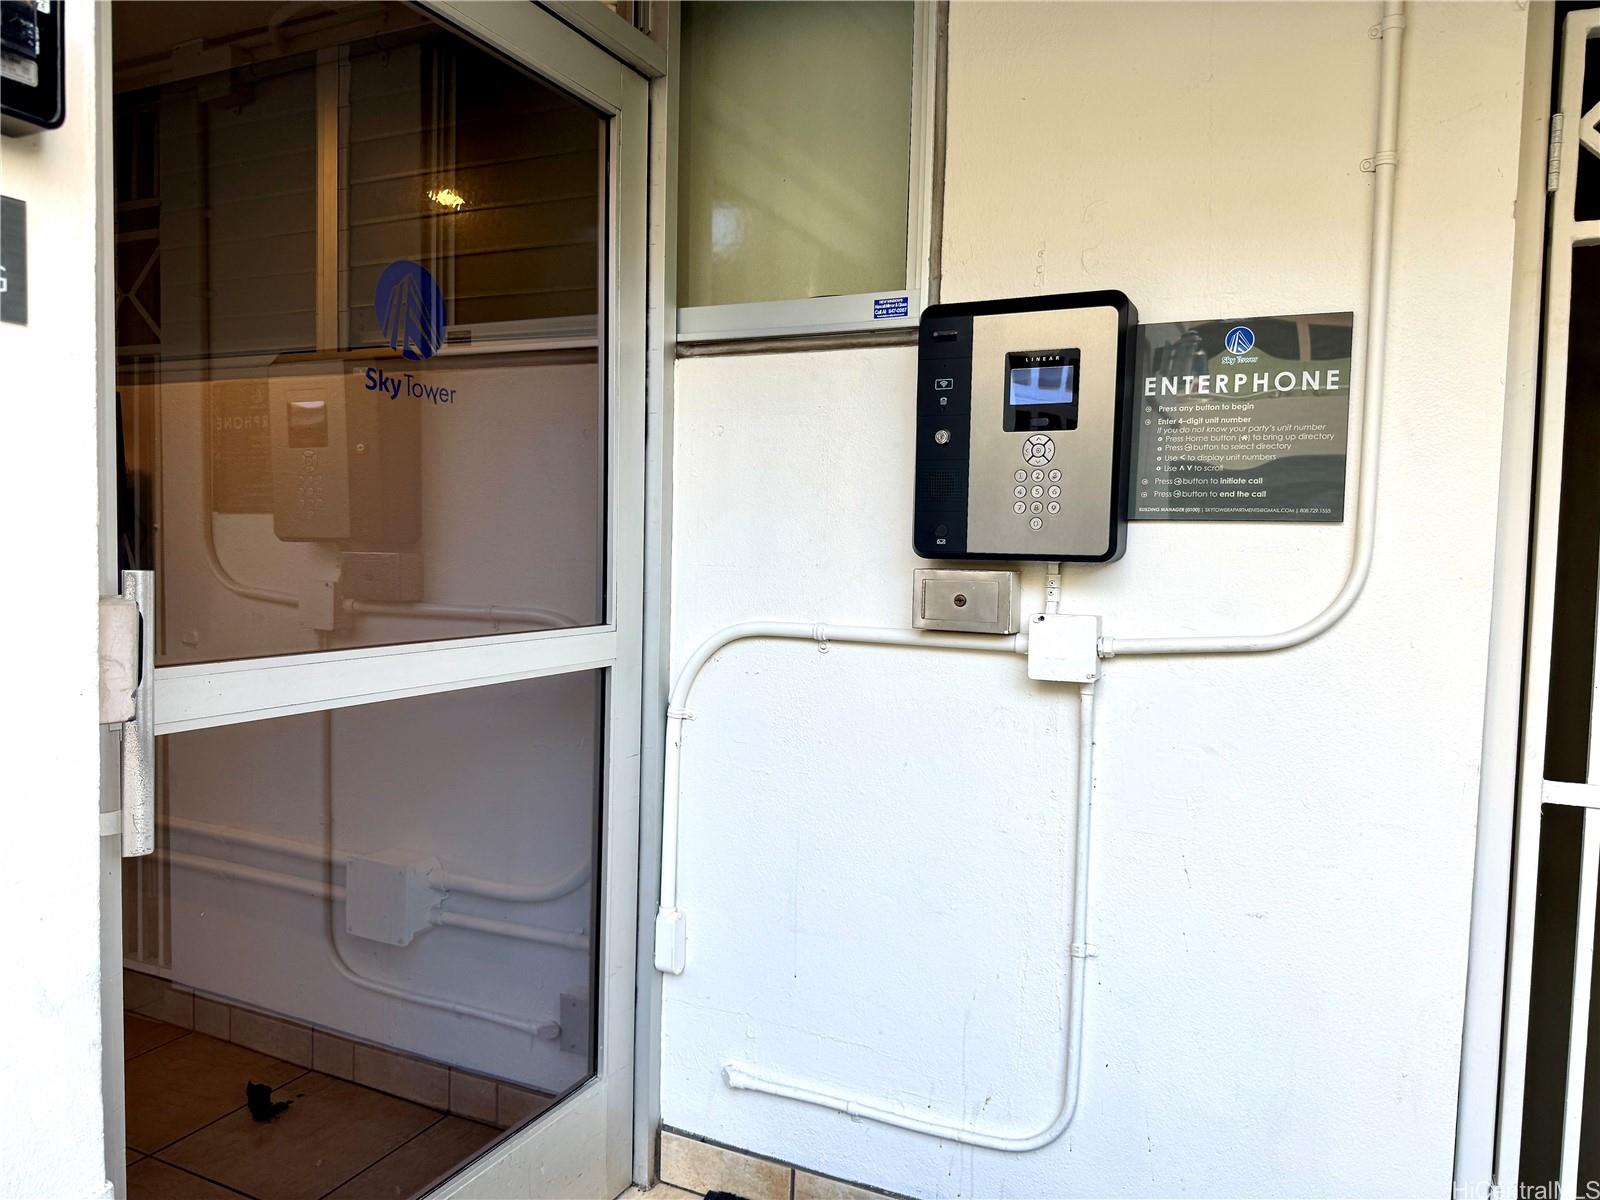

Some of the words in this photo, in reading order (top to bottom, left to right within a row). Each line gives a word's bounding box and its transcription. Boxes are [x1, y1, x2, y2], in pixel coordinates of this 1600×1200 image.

[1025, 355, 1060, 363] LINEAR
[1221, 356, 1236, 365] Sky
[1236, 355, 1258, 363] Tower
[365, 367, 402, 400] Sky
[403, 373, 456, 405] Tower
[1144, 369, 1340, 397] ENTERPHONE
[1158, 405, 1177, 413] Press
[1179, 405, 1194, 413] any
[1231, 402, 1255, 411] begin
[1228, 426, 1247, 434] your
[1247, 424, 1276, 433] party's
[1276, 424, 1292, 432] unit
[1293, 423, 1327, 431] number
[1210, 434, 1237, 442] button
[1252, 433, 1261, 441] to
[1262, 432, 1283, 442] bring
[1285, 433, 1297, 441] up
[1297, 432, 1335, 441] directory
[1193, 443, 1219, 451] button
[1230, 442, 1254, 450] select
[1255, 442, 1292, 450] directory
[1197, 453, 1225, 462] display
[1163, 464, 1178, 472] Use
[1182, 477, 1209, 485] button
[1219, 477, 1247, 485] initiate
[1209, 489, 1218, 497] to
[1219, 489, 1236, 497] end
[1236, 489, 1250, 497] the
[1251, 489, 1267, 497] call
